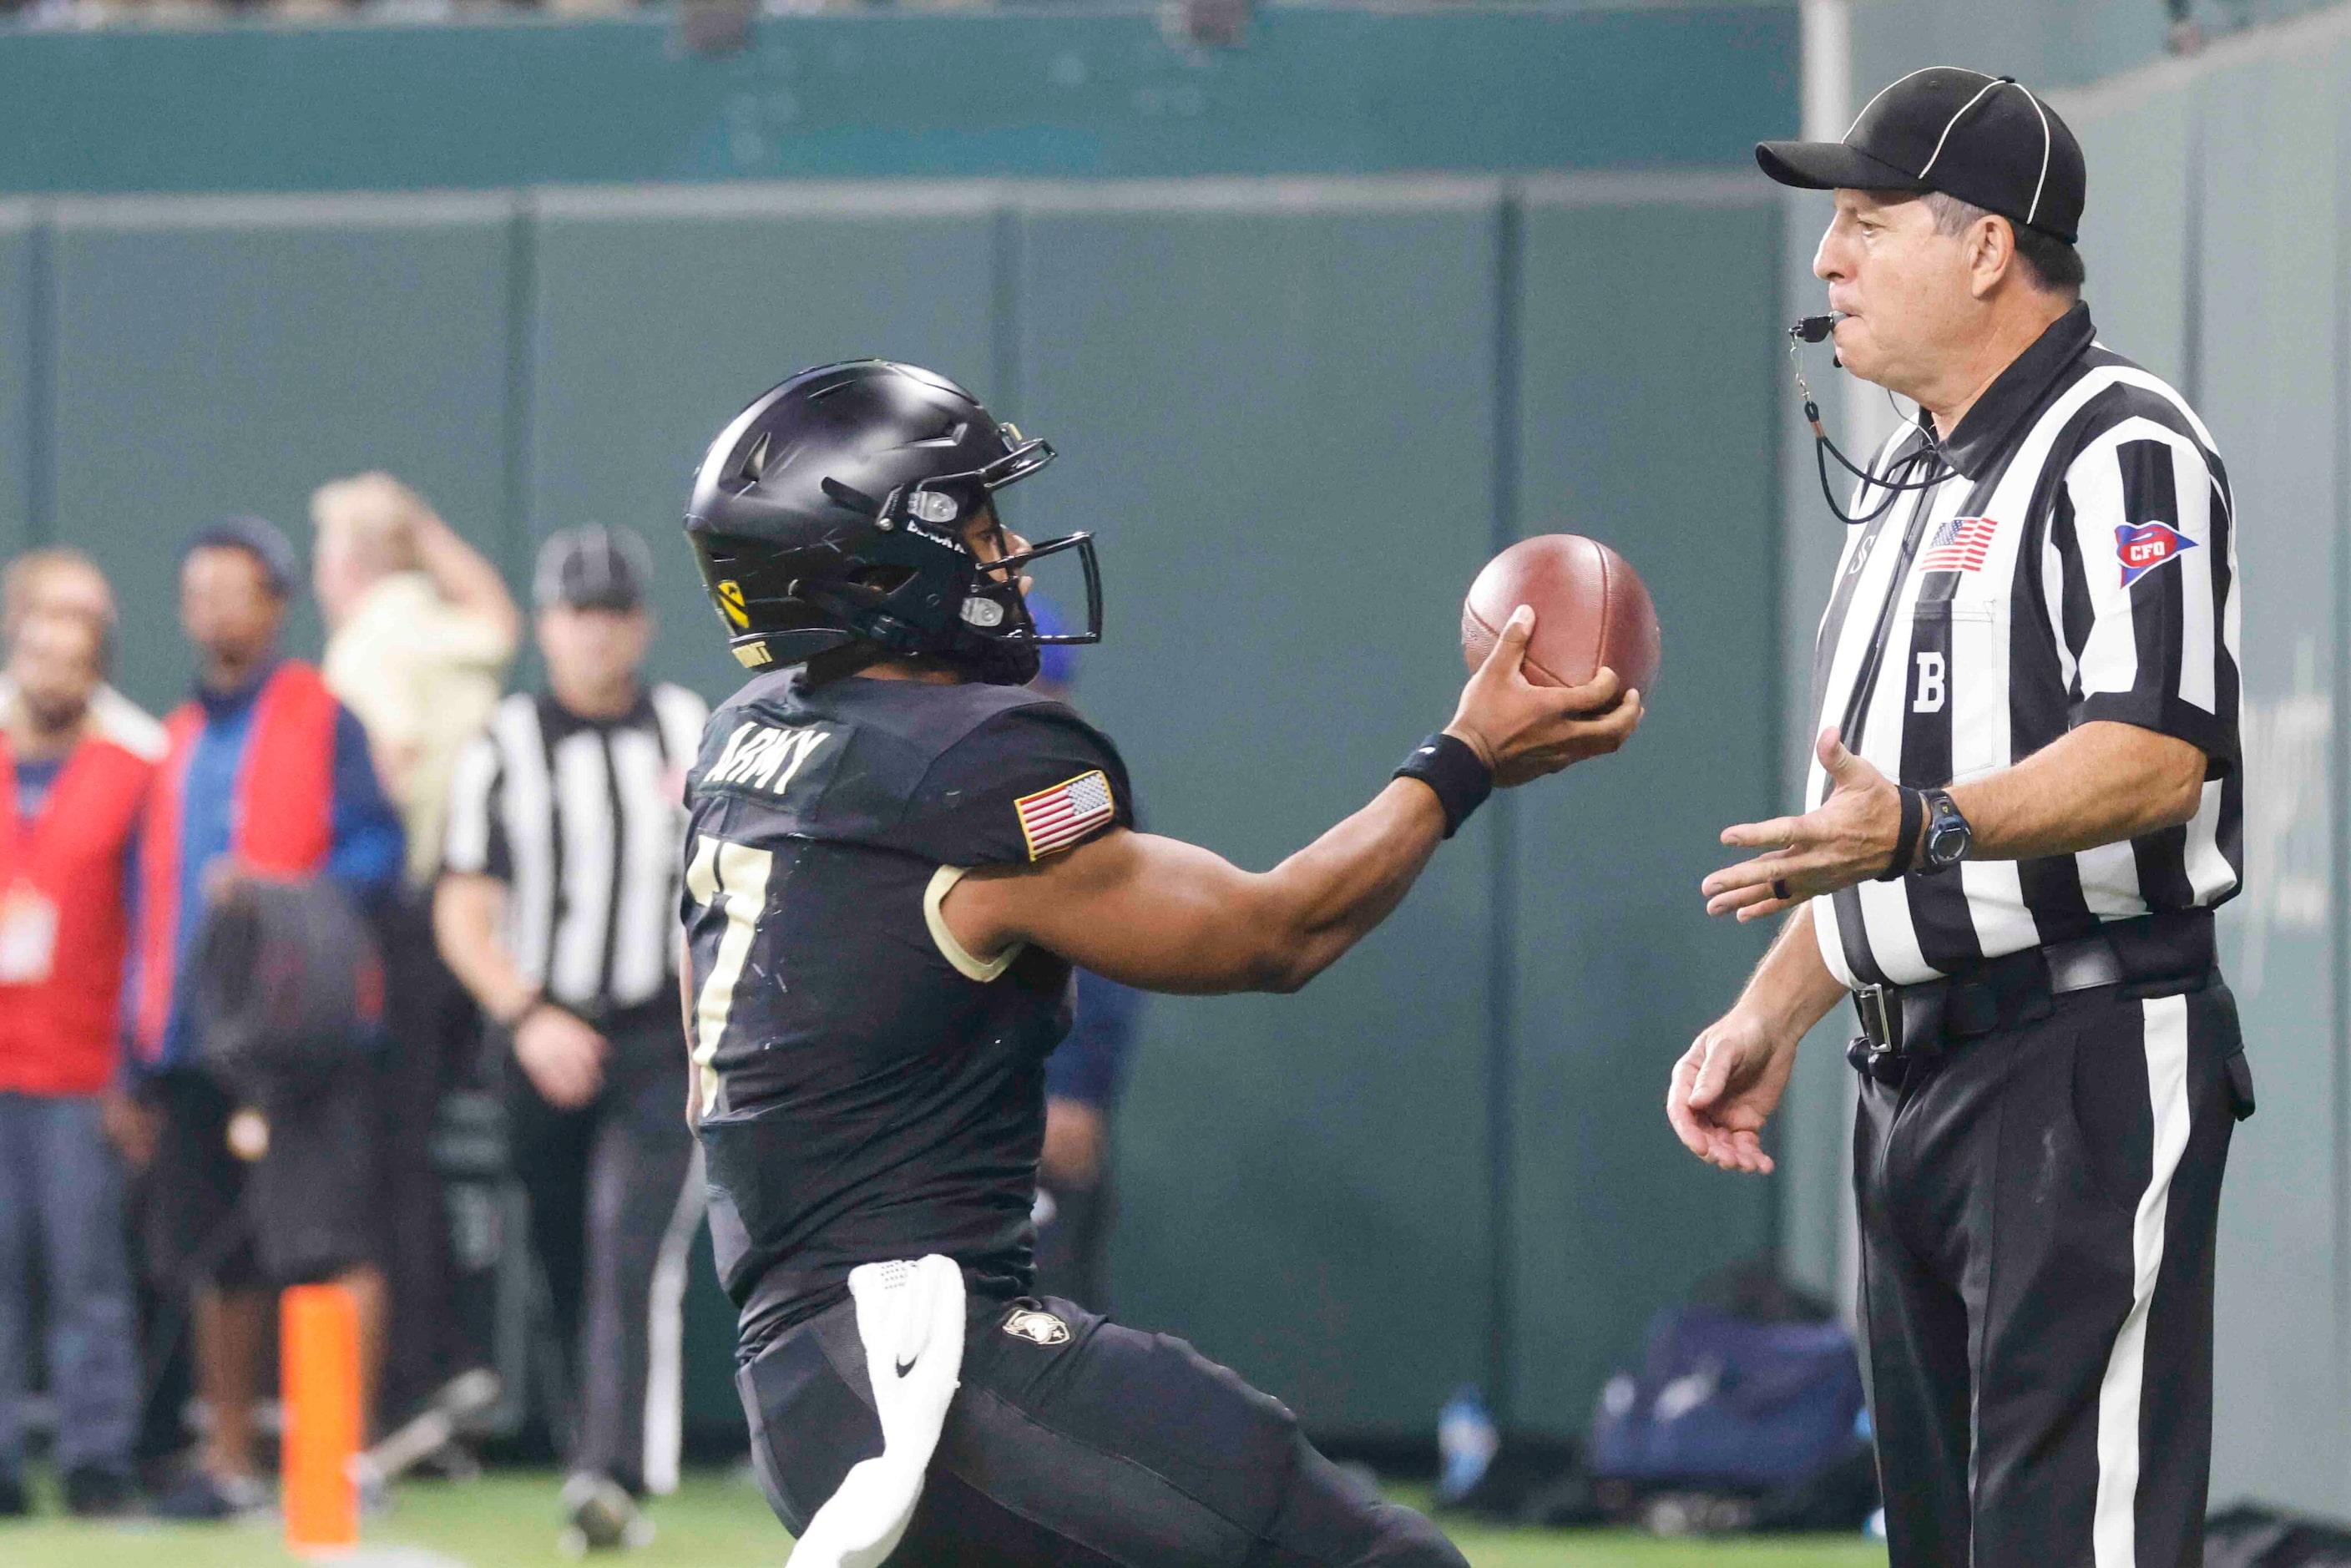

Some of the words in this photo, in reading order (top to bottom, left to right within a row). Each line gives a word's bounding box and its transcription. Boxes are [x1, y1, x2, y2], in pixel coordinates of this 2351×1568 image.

[2130, 541, 2166, 562] CFO
[1913, 651, 1945, 713] B
[703, 721, 832, 795] ARMY
